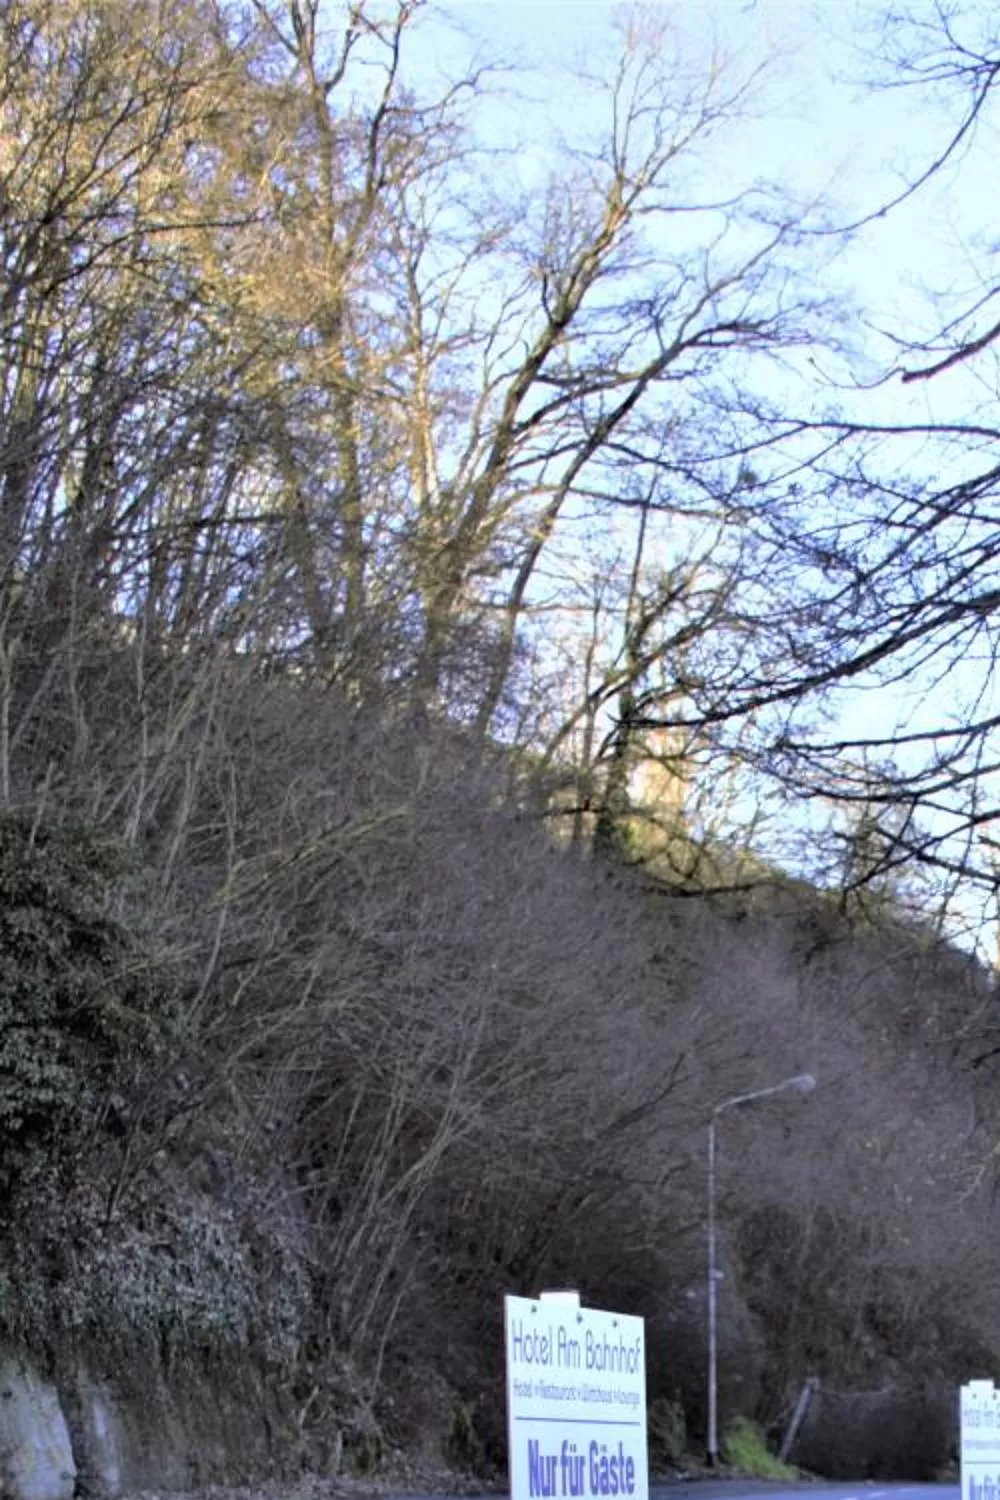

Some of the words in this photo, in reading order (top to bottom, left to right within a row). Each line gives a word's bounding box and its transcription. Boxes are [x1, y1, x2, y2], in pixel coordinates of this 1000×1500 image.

[512, 1319, 553, 1366] Hotel
[557, 1325, 581, 1369] Am
[585, 1328, 641, 1374] Bahnhof
[527, 1438, 557, 1498] Nur
[560, 1438, 586, 1497] für
[589, 1439, 635, 1497] Gäste
